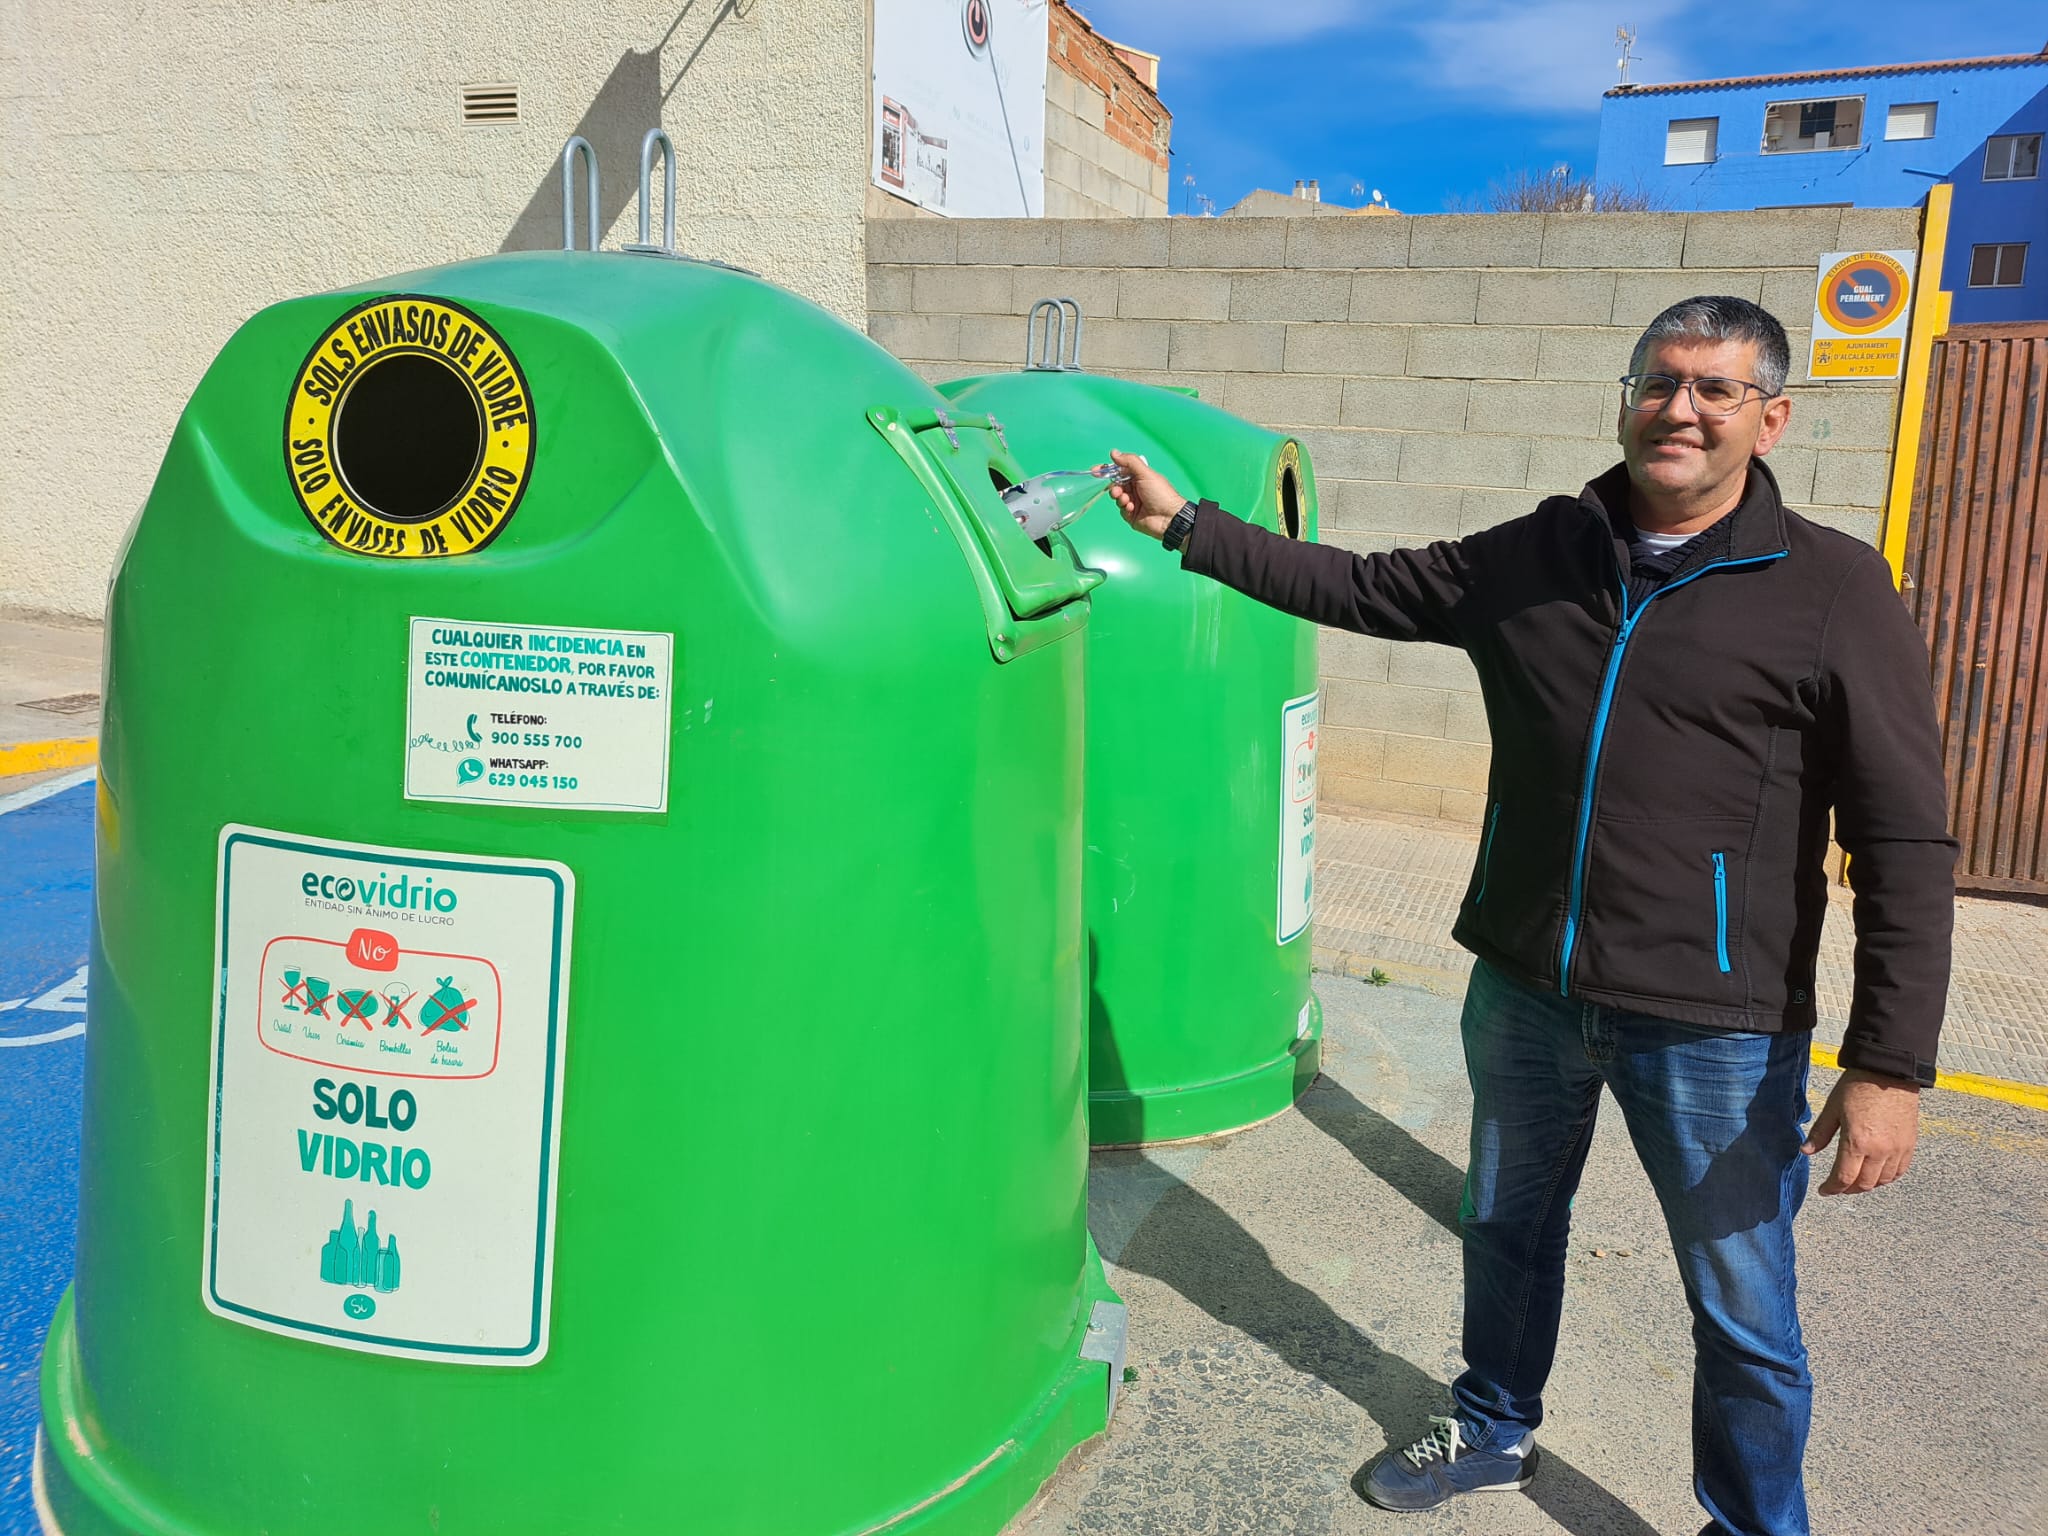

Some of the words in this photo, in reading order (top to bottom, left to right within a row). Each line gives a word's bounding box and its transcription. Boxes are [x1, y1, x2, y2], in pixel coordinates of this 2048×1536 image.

[1828, 257, 1851, 278] EIXIDA
[1869, 253, 1905, 275] VEHICLES
[1840, 294, 1885, 303] PERMANENT
[1853, 285, 1873, 294] GUAL
[304, 338, 356, 407] SOLS
[347, 305, 450, 357] ENVASOS
[448, 324, 485, 369] DE
[472, 350, 527, 432] VIDRE
[1877, 352, 1899, 360] XIVERT
[293, 439, 330, 494] SOLO
[318, 493, 407, 554] ENVASES
[420, 524, 448, 554] DE
[449, 465, 517, 544] VIDRIO
[432, 628, 523, 650] CUALQUIER
[528, 634, 625, 657] INCIDENCIA
[627, 645, 646, 658] EN
[425, 652, 459, 666] ESTE
[460, 651, 575, 675] CONTENEDOR,
[578, 662, 606, 676] POR
[609, 664, 655, 679] FAVOR
[425, 670, 562, 695] COMUNÍCANOSLO
[566, 682, 577, 695] A
[578, 680, 635, 698] TRAVÉS
[638, 686, 660, 699] DE:
[490, 711, 547, 725] TELÉFONO:
[491, 731, 519, 745] 900
[523, 733, 550, 747] 555
[554, 735, 582, 748] 700
[489, 758, 549, 770] WHATSAPP:
[488, 772, 515, 786] 629
[519, 774, 548, 788] 045
[552, 776, 578, 790] 150
[302, 872, 458, 913] ecovidrio
[304, 898, 345, 912] ENTIDAD
[347, 905, 362, 915] SIN
[401, 912, 416, 922] DE
[418, 915, 455, 926] LUCRO
[312, 1078, 417, 1132] SOLO
[297, 1128, 431, 1190] VIDRIO
